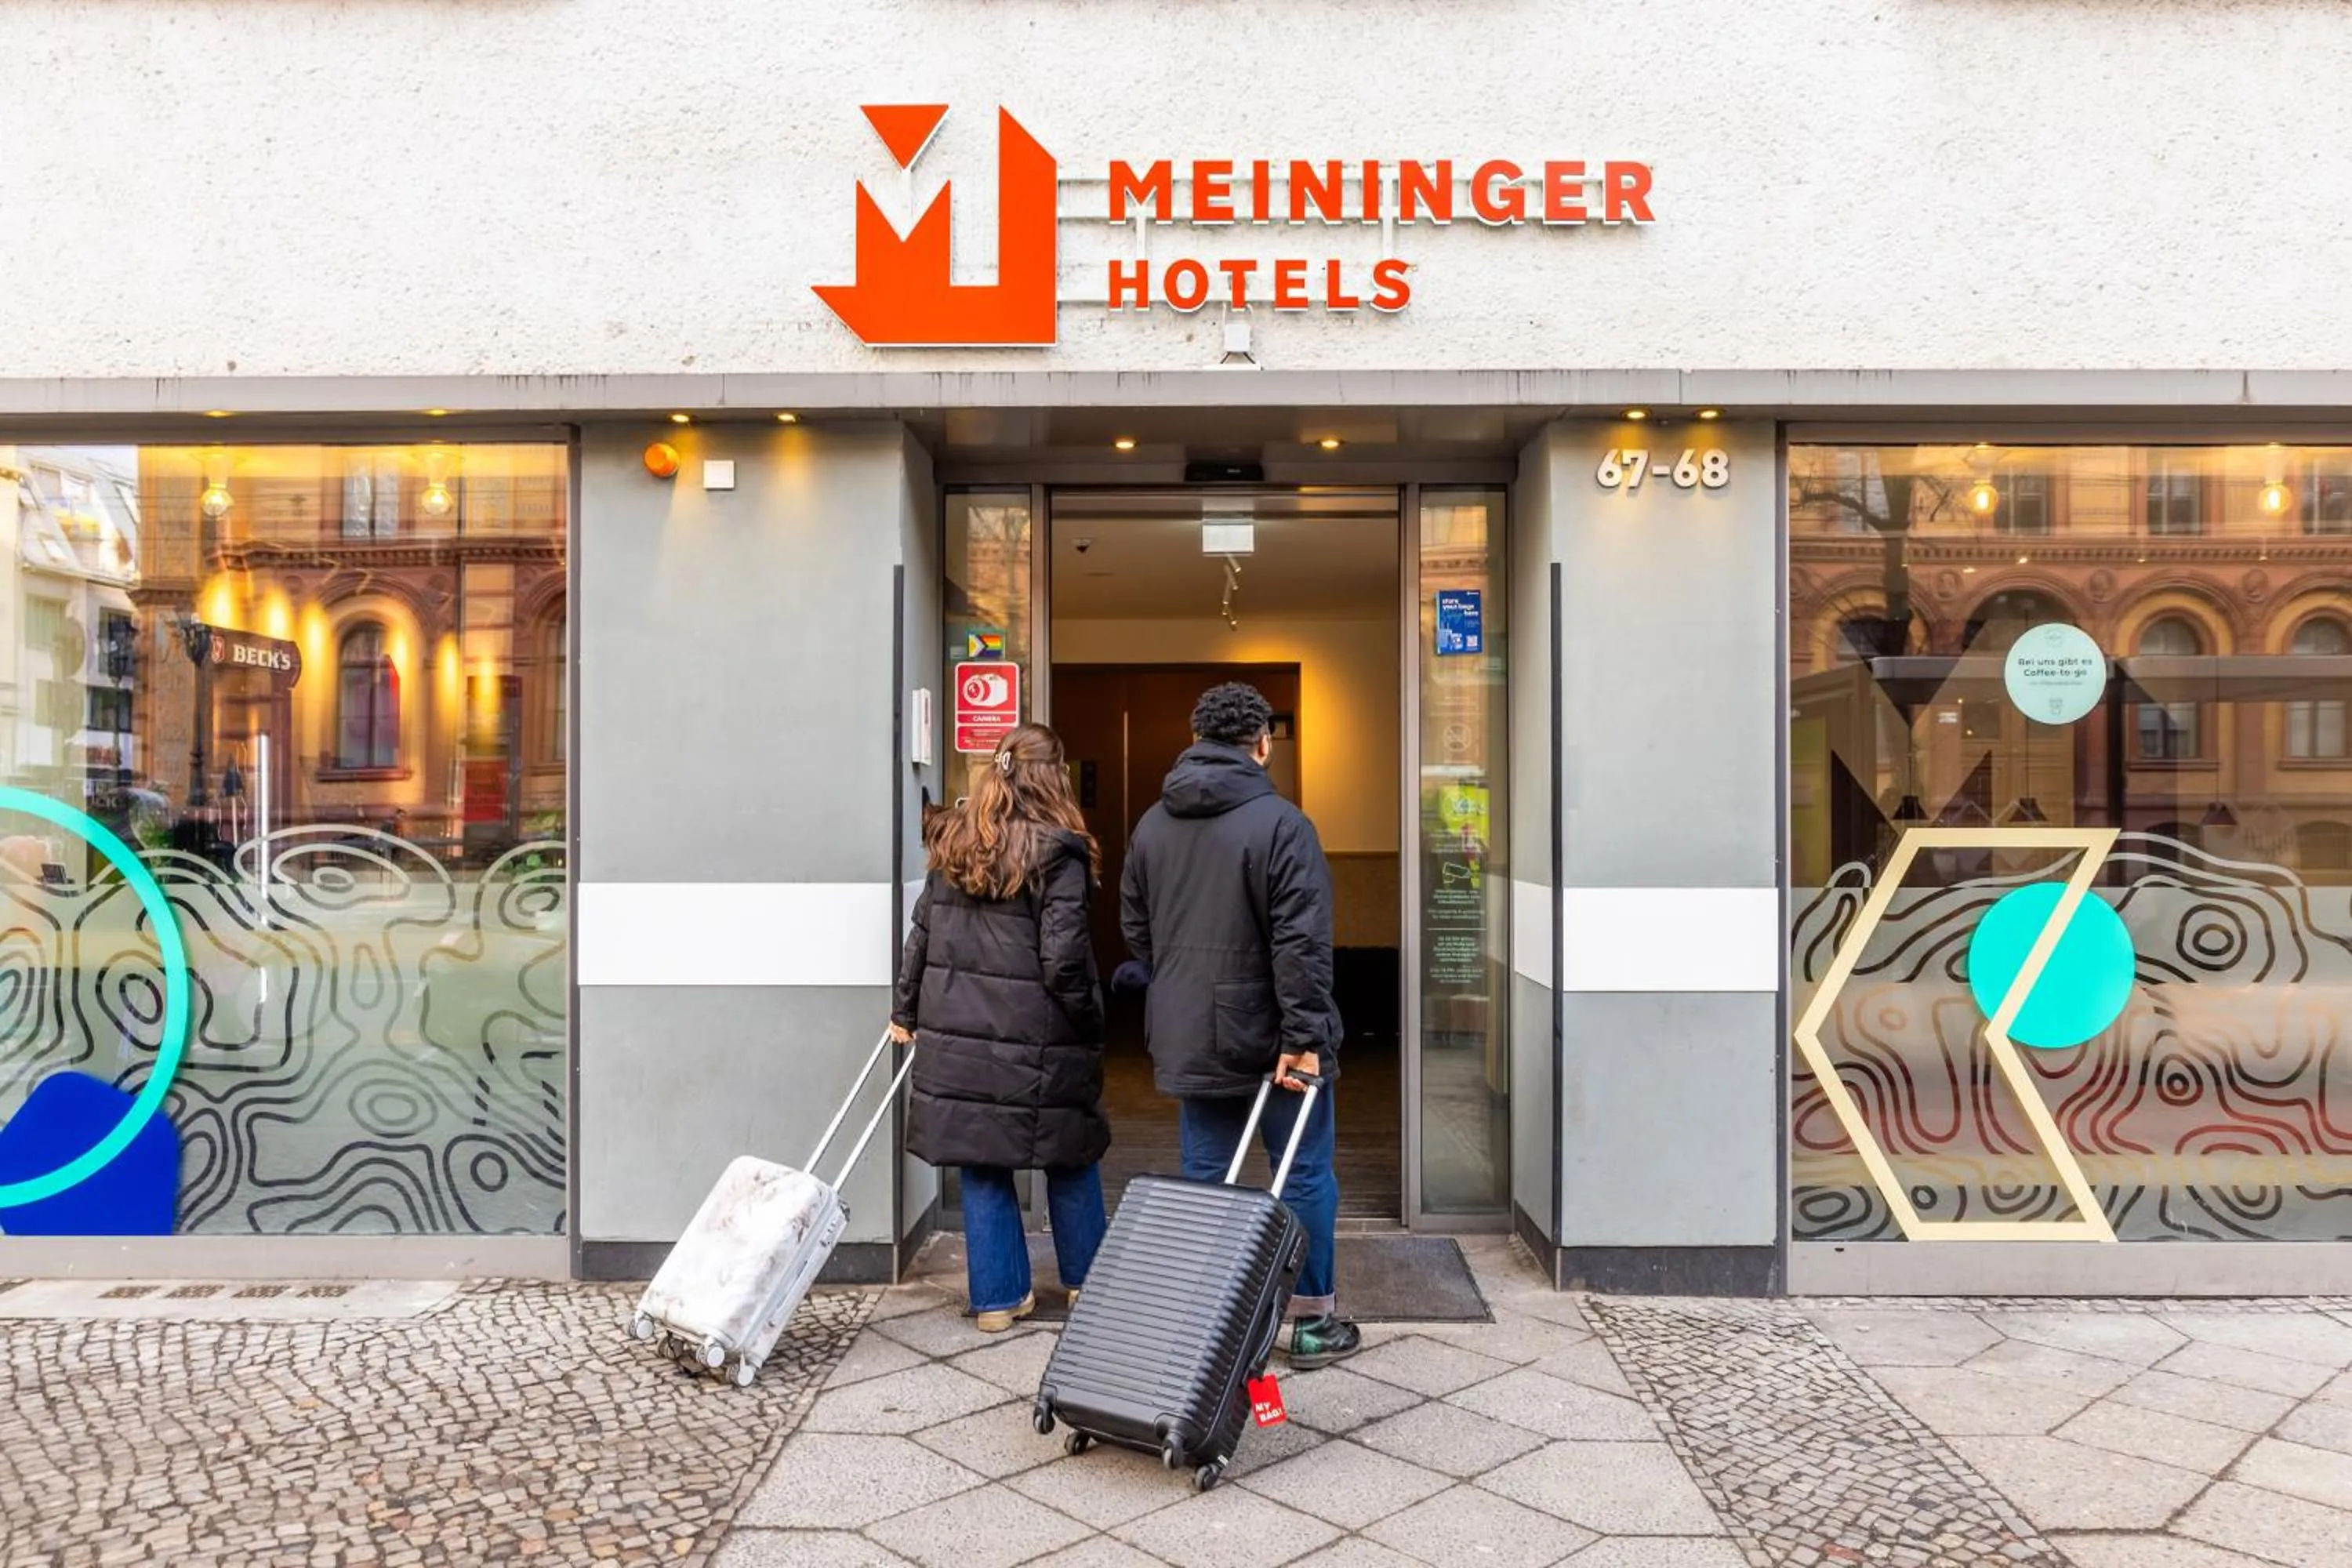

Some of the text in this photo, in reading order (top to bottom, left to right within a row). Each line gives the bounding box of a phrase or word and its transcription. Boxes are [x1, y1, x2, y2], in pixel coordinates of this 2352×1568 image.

[1108, 159, 1656, 223] MEININGER
[1108, 258, 1412, 311] HOTELS
[1596, 448, 1730, 489] 67-68
[232, 644, 291, 670] BECK'S
[2058, 658, 2078, 666] gibt
[1255, 1402, 1271, 1412] MY
